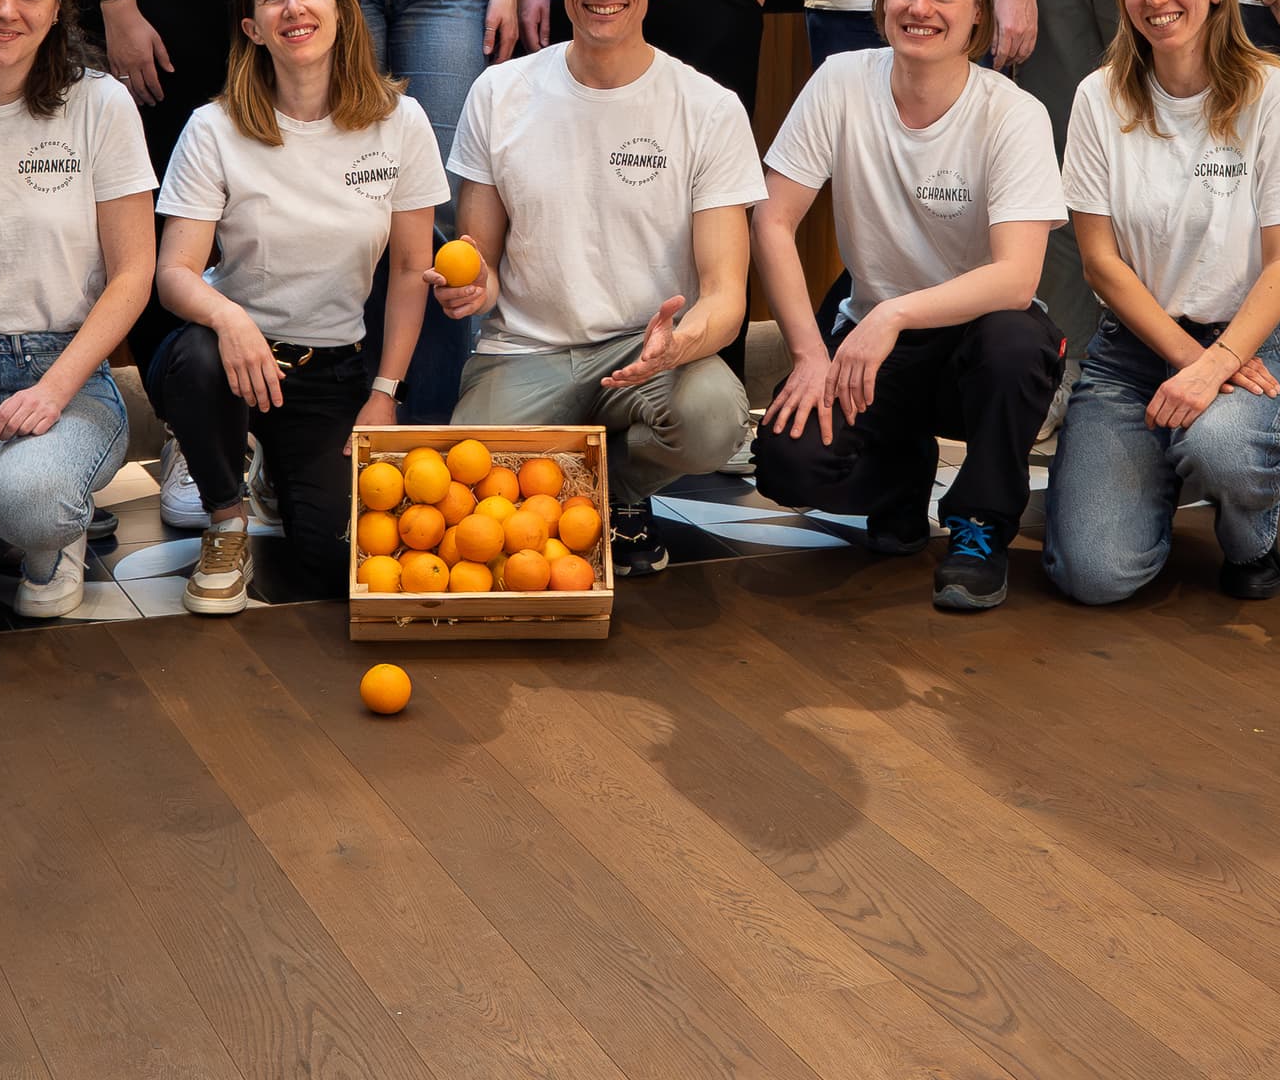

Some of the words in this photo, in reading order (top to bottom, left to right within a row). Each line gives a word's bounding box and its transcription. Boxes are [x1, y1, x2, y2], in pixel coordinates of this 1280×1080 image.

[18, 159, 81, 174] SCHRANKERL
[609, 152, 667, 168] SCHRANKERL
[345, 166, 400, 186] SCHRANKER
[916, 186, 972, 202] SCHRANKERL
